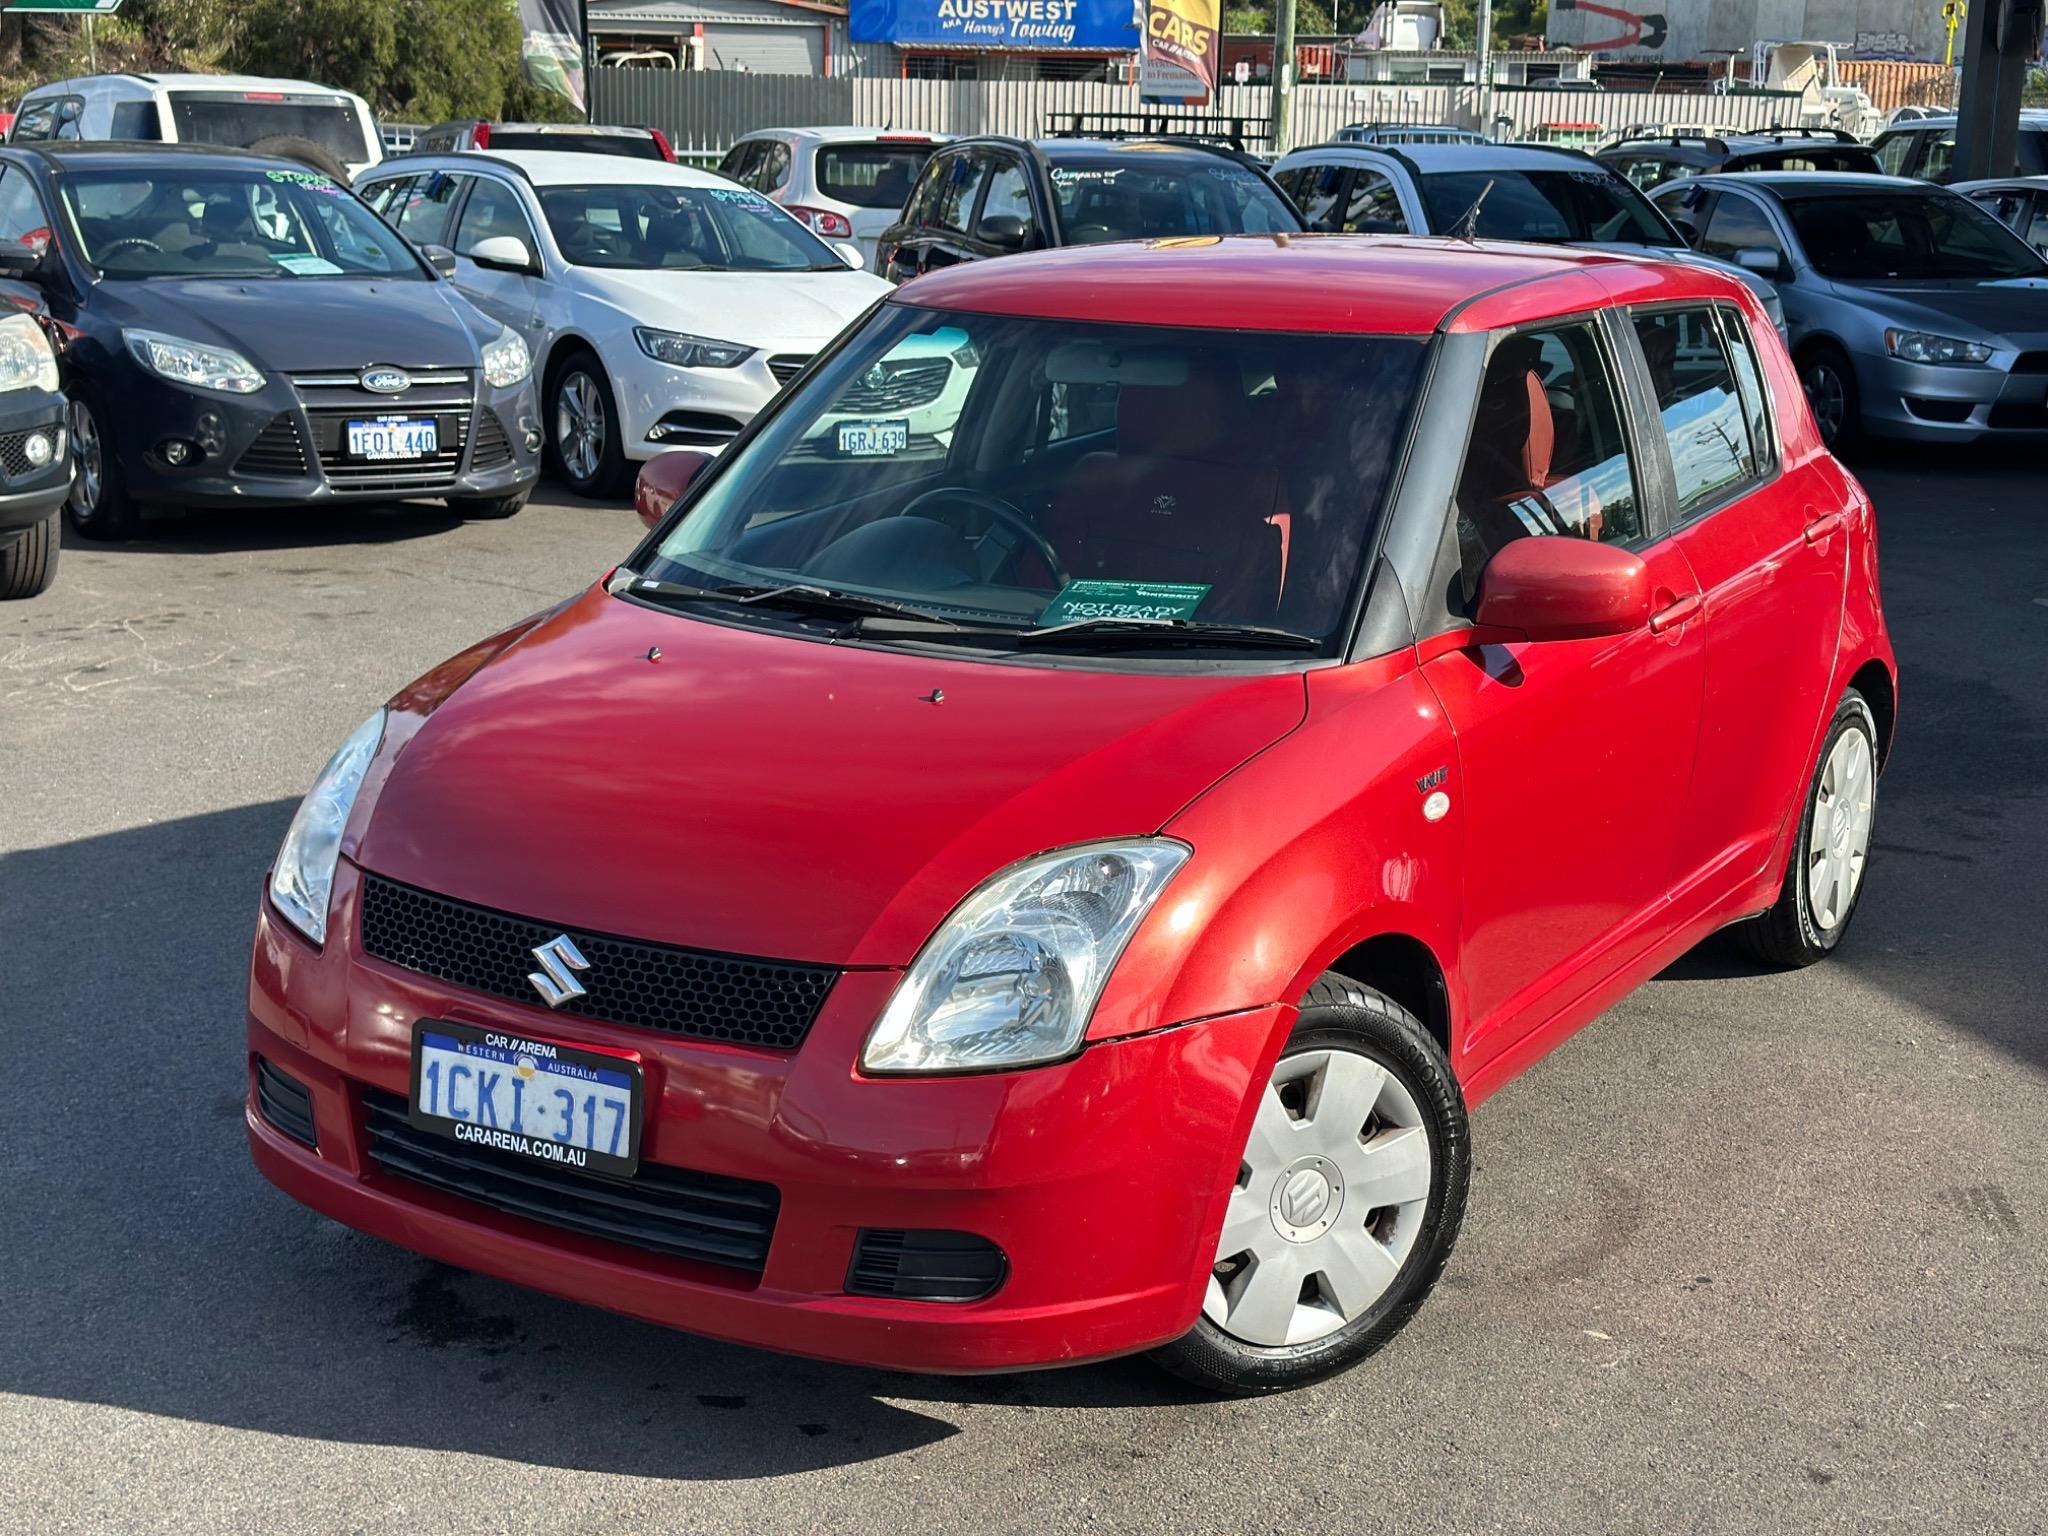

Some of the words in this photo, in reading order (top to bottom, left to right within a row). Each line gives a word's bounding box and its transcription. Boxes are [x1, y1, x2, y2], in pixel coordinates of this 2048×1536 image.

[937, 0, 1077, 20] AUSTWEST
[1010, 17, 1076, 43] Towing
[1149, 11, 1210, 56] CARS
[405, 431, 434, 452] 440
[1063, 602, 1111, 611] NOT
[1112, 603, 1185, 614] READY
[1068, 609, 1113, 617] FOR
[1115, 610, 1170, 620] SALE
[485, 1033, 508, 1049] CAR
[518, 1041, 558, 1060] ARENA
[457, 1043, 506, 1062] WESTERN
[547, 1062, 598, 1081] AUSTRALIA
[454, 1123, 587, 1167] CARARENA.COM.AU
